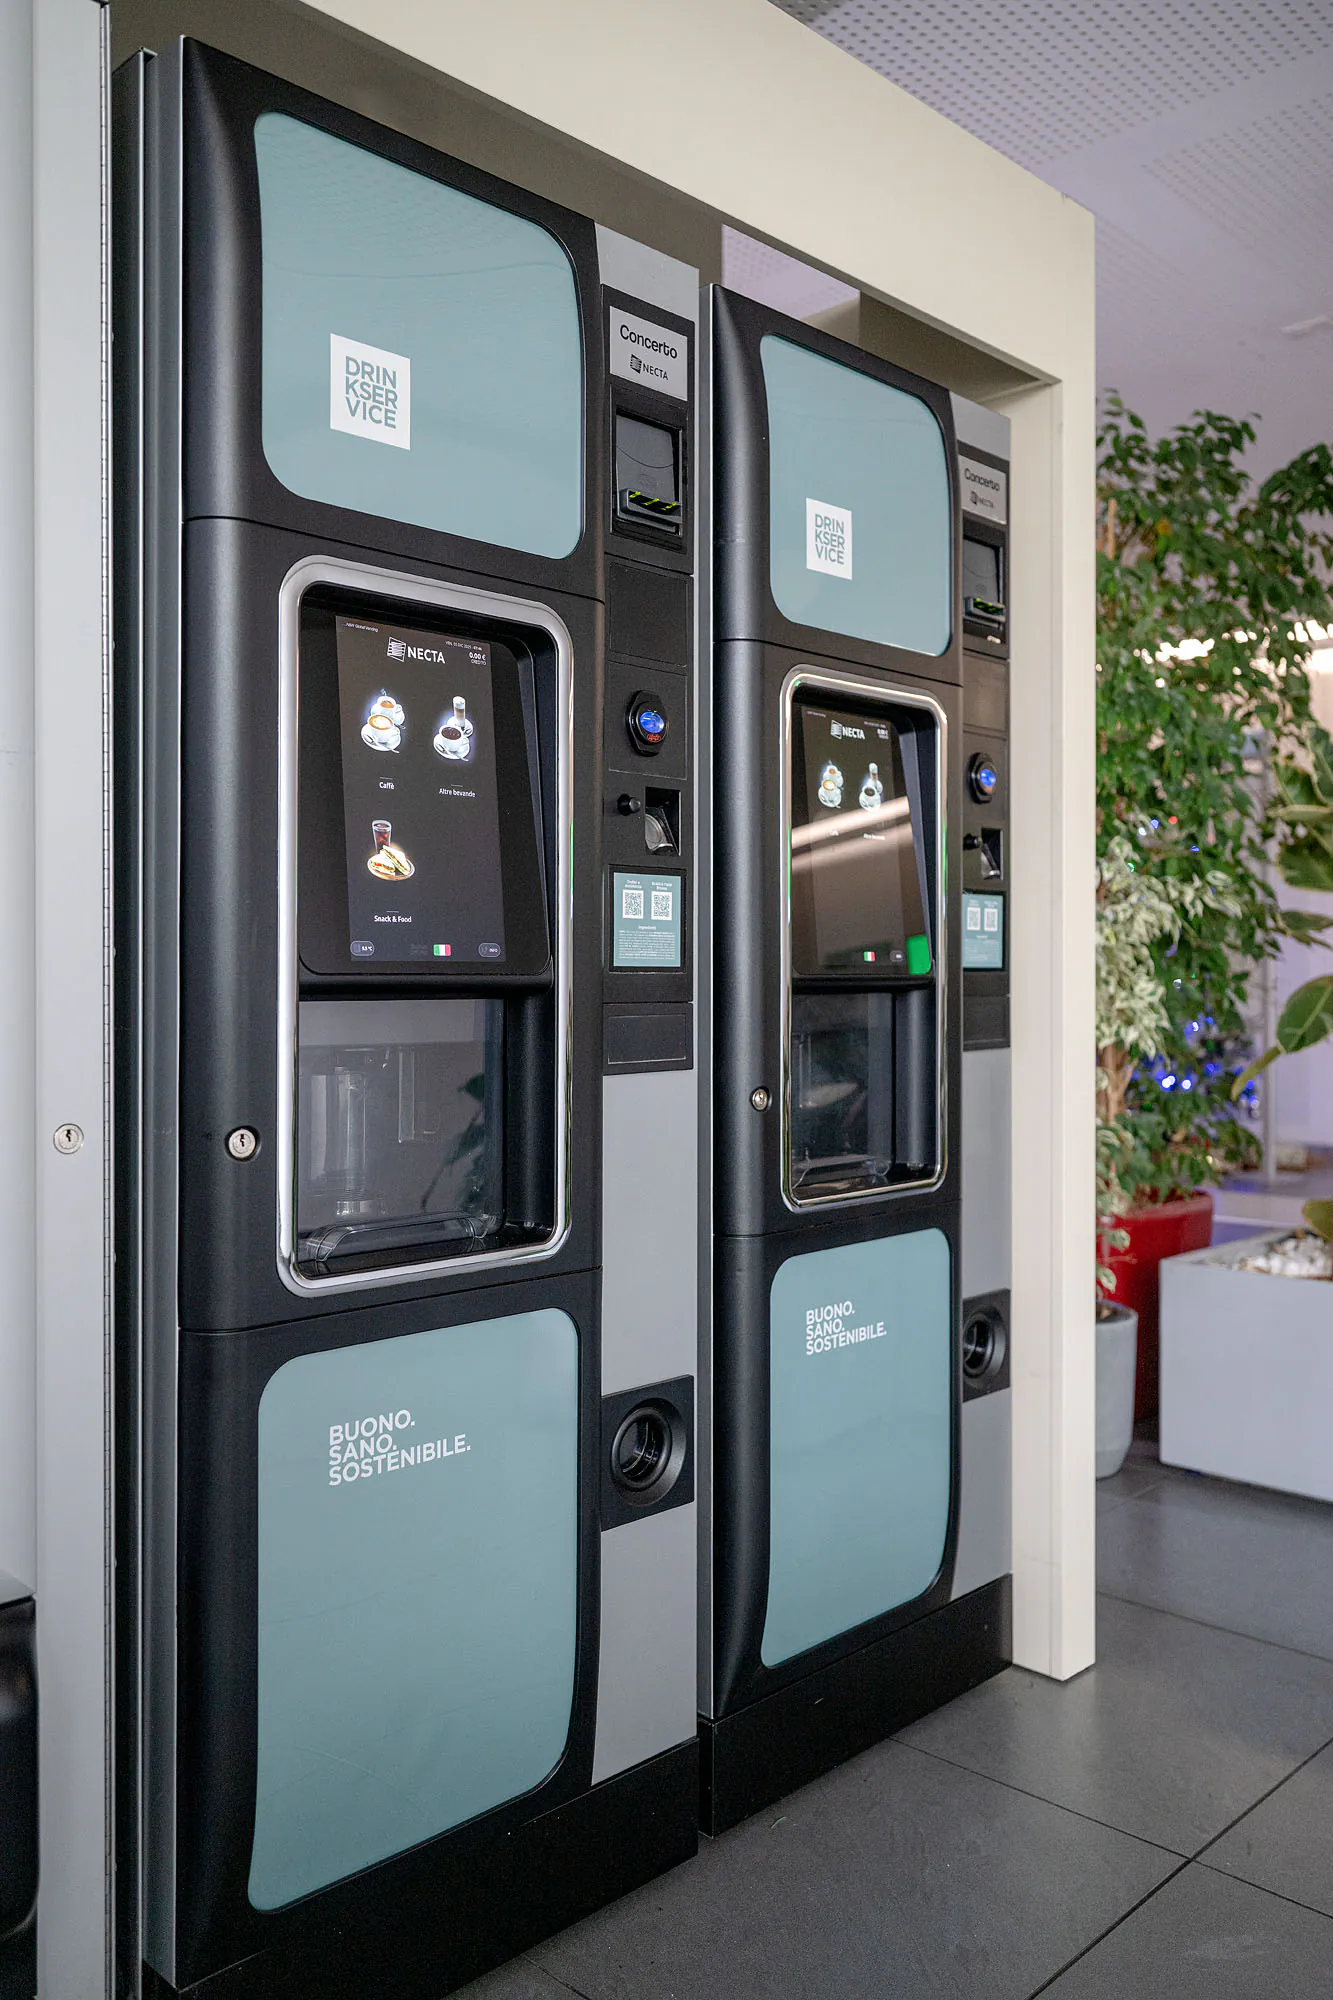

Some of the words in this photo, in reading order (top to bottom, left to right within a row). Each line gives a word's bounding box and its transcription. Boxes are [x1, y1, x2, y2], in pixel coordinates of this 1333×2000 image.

[620, 324, 678, 359] Concerto
[345, 355, 397, 390] DRIN
[642, 362, 669, 381] NECTA
[345, 375, 398, 410] KSER
[345, 396, 397, 429] VICE
[815, 513, 845, 536] DRIN
[815, 528, 846, 551] KSER
[815, 543, 845, 566] VICE
[407, 646, 446, 664] NECTA
[842, 726, 866, 740] NECTA
[379, 781, 395, 790] Caffè
[439, 788, 453, 796] Altre
[452, 788, 476, 798] bevande
[374, 915, 392, 923] Snack
[806, 1300, 856, 1325] BUONO.
[806, 1318, 846, 1340] SANO.
[806, 1321, 888, 1356] SOSTENIBILE.
[329, 1409, 416, 1446] BUONO.
[329, 1433, 397, 1466] SANO.
[329, 1434, 471, 1486] SOSTENIBILE.
